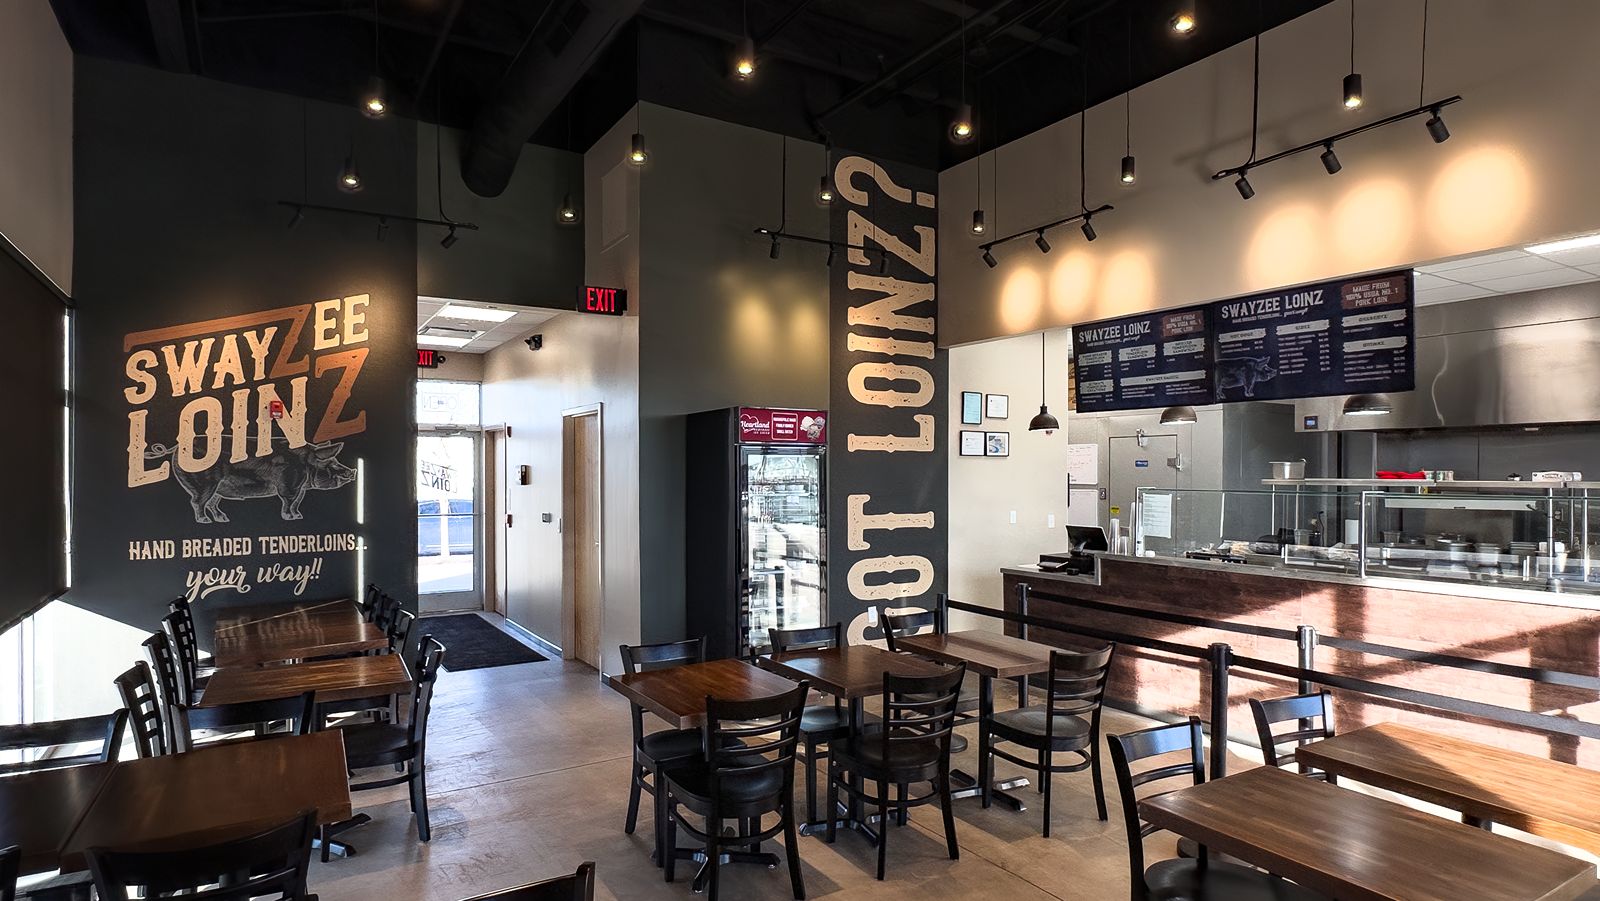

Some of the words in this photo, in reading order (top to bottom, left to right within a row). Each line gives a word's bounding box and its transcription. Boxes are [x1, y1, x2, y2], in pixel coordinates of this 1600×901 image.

[586, 287, 617, 312] EXIT
[835, 156, 935, 453] LOINZ?
[1221, 297, 1281, 319] SWAYZEE
[1285, 290, 1324, 310] LOINZ
[1079, 326, 1121, 343] SWAYZEE
[1123, 320, 1151, 336] LOINZ
[123, 294, 370, 404] SWAYZEE
[416, 350, 434, 366] XIT
[127, 347, 370, 488] LOINZ
[128, 540, 176, 560] HAND
[182, 537, 251, 559] BREADED
[185, 564, 251, 604] your
[257, 557, 324, 596] way!!
